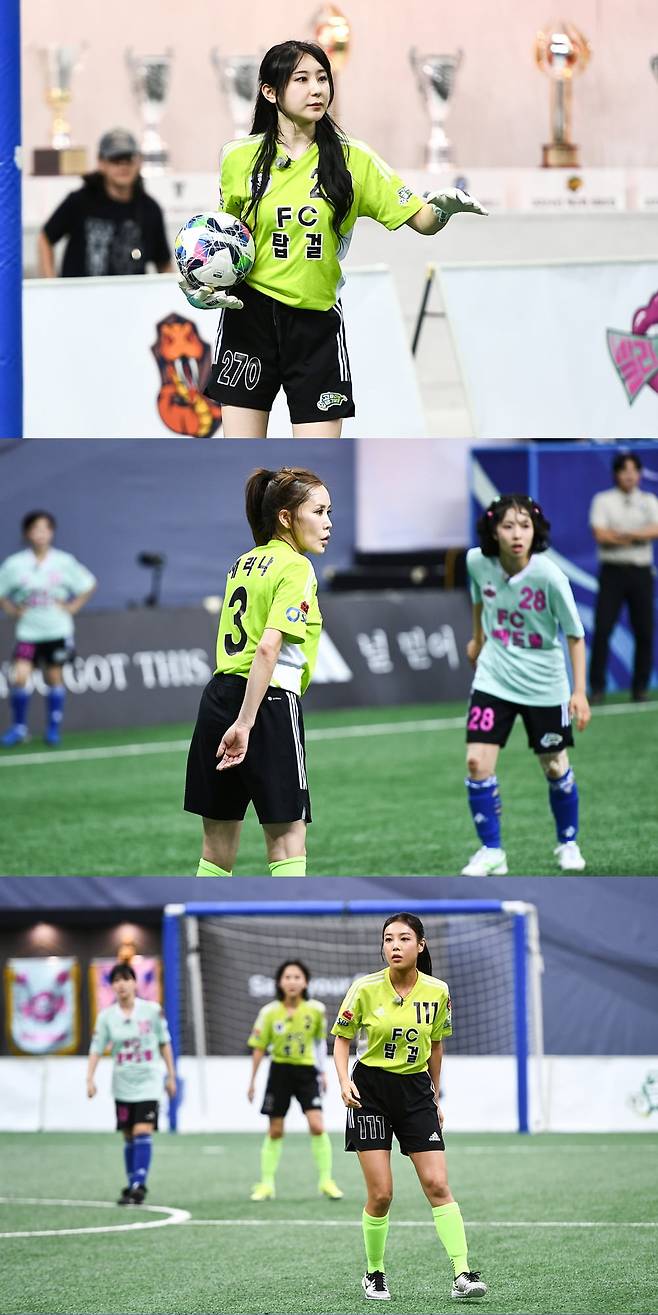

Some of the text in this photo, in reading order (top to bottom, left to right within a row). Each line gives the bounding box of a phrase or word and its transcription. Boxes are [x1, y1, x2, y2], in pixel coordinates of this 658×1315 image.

[276, 205, 319, 229] FC
[271, 232, 323, 260] 탑걸
[217, 350, 262, 391] 270
[519, 586, 547, 613] 28
[224, 586, 248, 656] 3
[497, 608, 525, 629] FC
[62, 653, 129, 694] GOT
[133, 648, 213, 690] THIS
[467, 705, 495, 732] 28
[413, 1001, 439, 1024] 111
[391, 1028, 419, 1043] FC
[384, 1043, 419, 1064] 탑걸
[357, 1115, 386, 1140] 111
